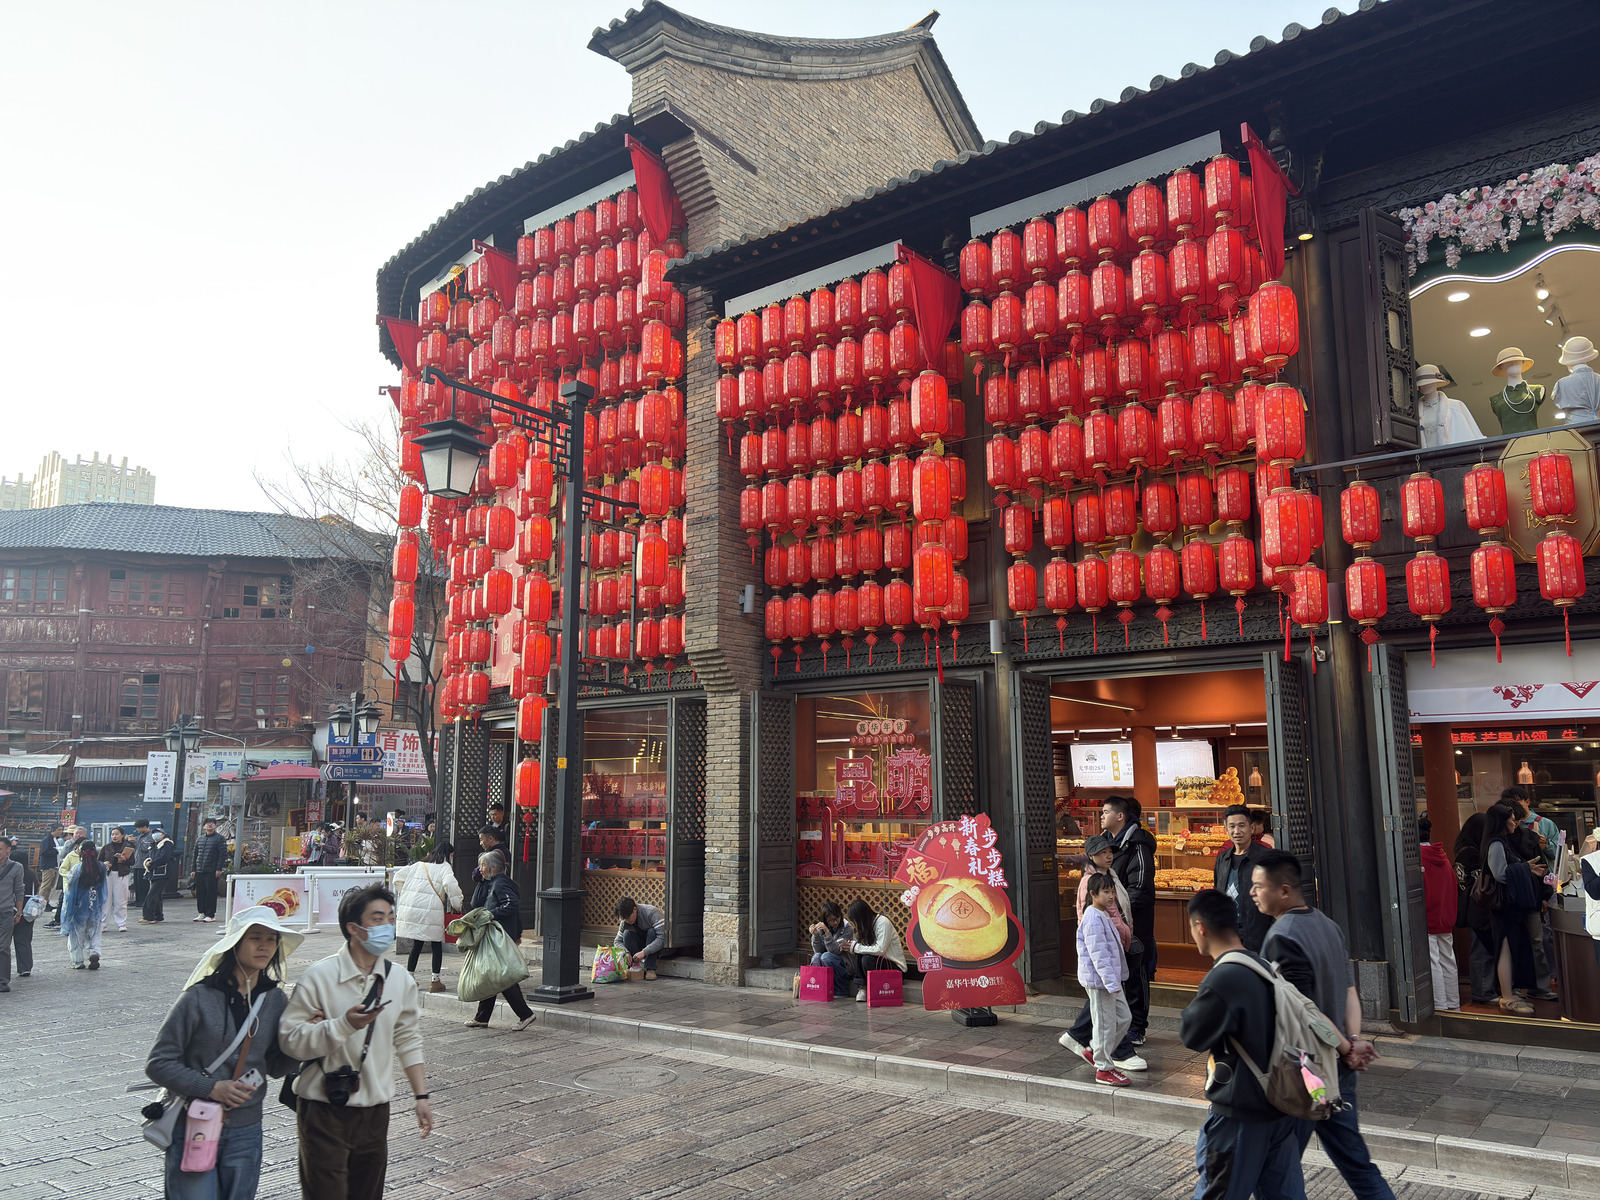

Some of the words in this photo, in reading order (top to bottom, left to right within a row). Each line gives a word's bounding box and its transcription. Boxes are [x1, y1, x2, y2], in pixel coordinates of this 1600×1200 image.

[307, 801, 320, 822] 刻章
[958, 815, 989, 876] 新春礼
[981, 827, 1009, 888] 步步糕
[905, 856, 939, 886] 福
